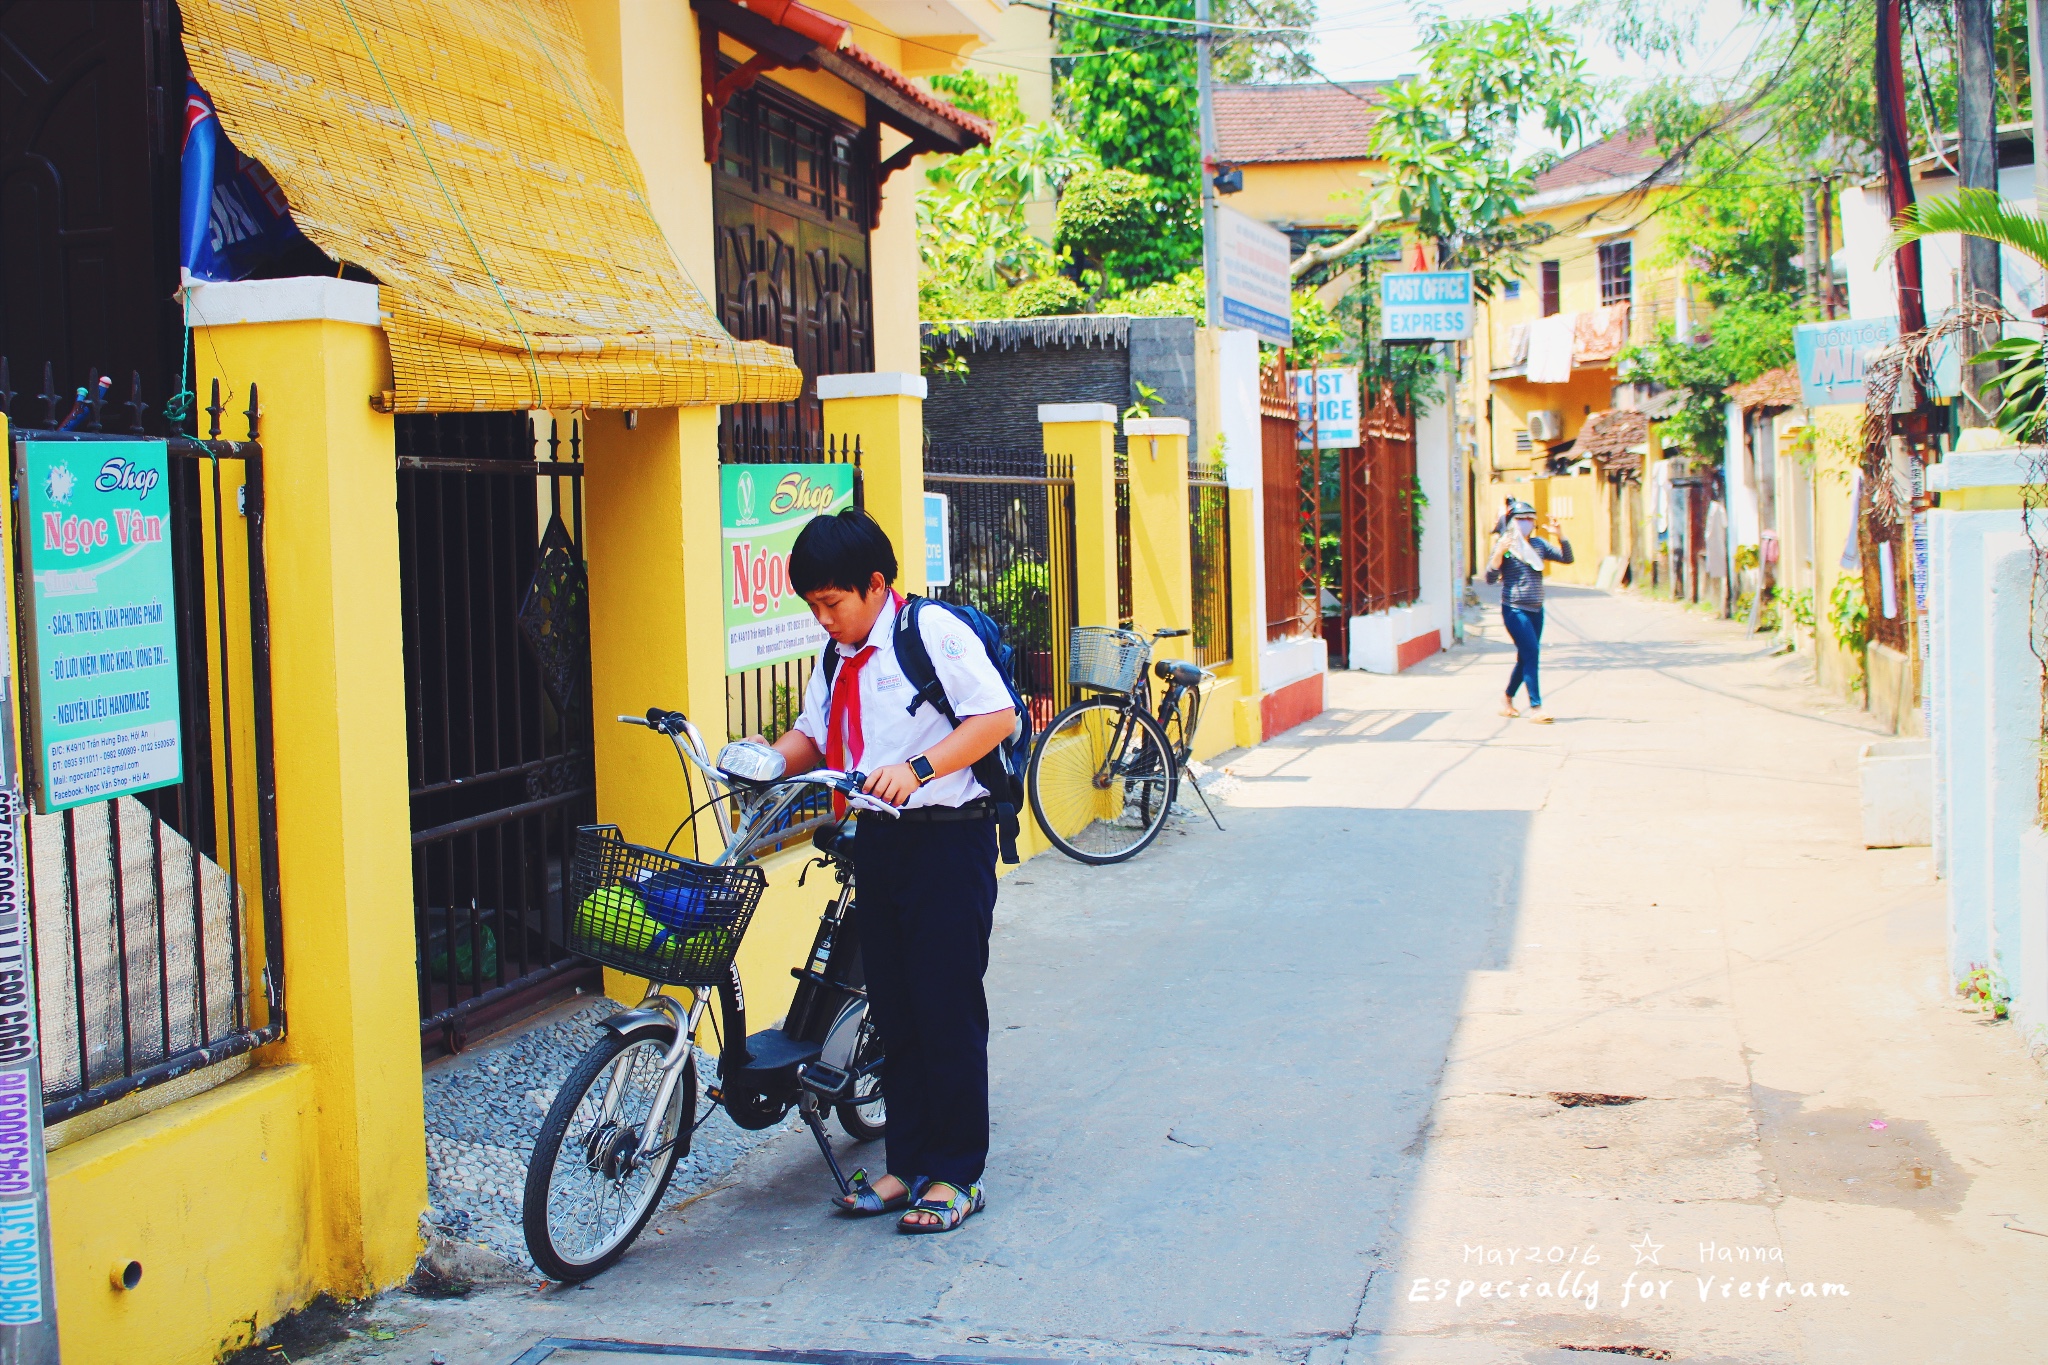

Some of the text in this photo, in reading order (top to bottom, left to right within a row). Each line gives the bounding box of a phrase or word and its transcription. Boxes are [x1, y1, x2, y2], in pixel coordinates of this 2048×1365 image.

[1389, 276, 1465, 300] POST OFFICE
[1390, 312, 1464, 333] EXPRESS
[1816, 324, 1888, 348] UỐN TÓC
[95, 457, 159, 500] Shop
[770, 471, 834, 516] Shop
[43, 509, 162, 556] Ngọc Vân
[52, 611, 74, 635] SÁCH,
[75, 607, 104, 635] TRUYỆN,
[104, 606, 119, 630] VĂN
[119, 603, 143, 628] PHÒNG
[143, 597, 163, 624] PHẨM
[54, 653, 64, 680] ĐỒ
[100, 650, 115, 674] MÓC
[135, 643, 153, 668] VÒNG
[57, 697, 90, 725] NGUYÊN
[91, 694, 107, 722] LIỆU
[109, 690, 150, 716] HANDMADE
[130, 732, 140, 742] Hội
[141, 730, 149, 739] An
[113, 777, 128, 788] Shop
[142, 772, 151, 780] An
[0, 1203, 40, 1323] 0916.006.311
